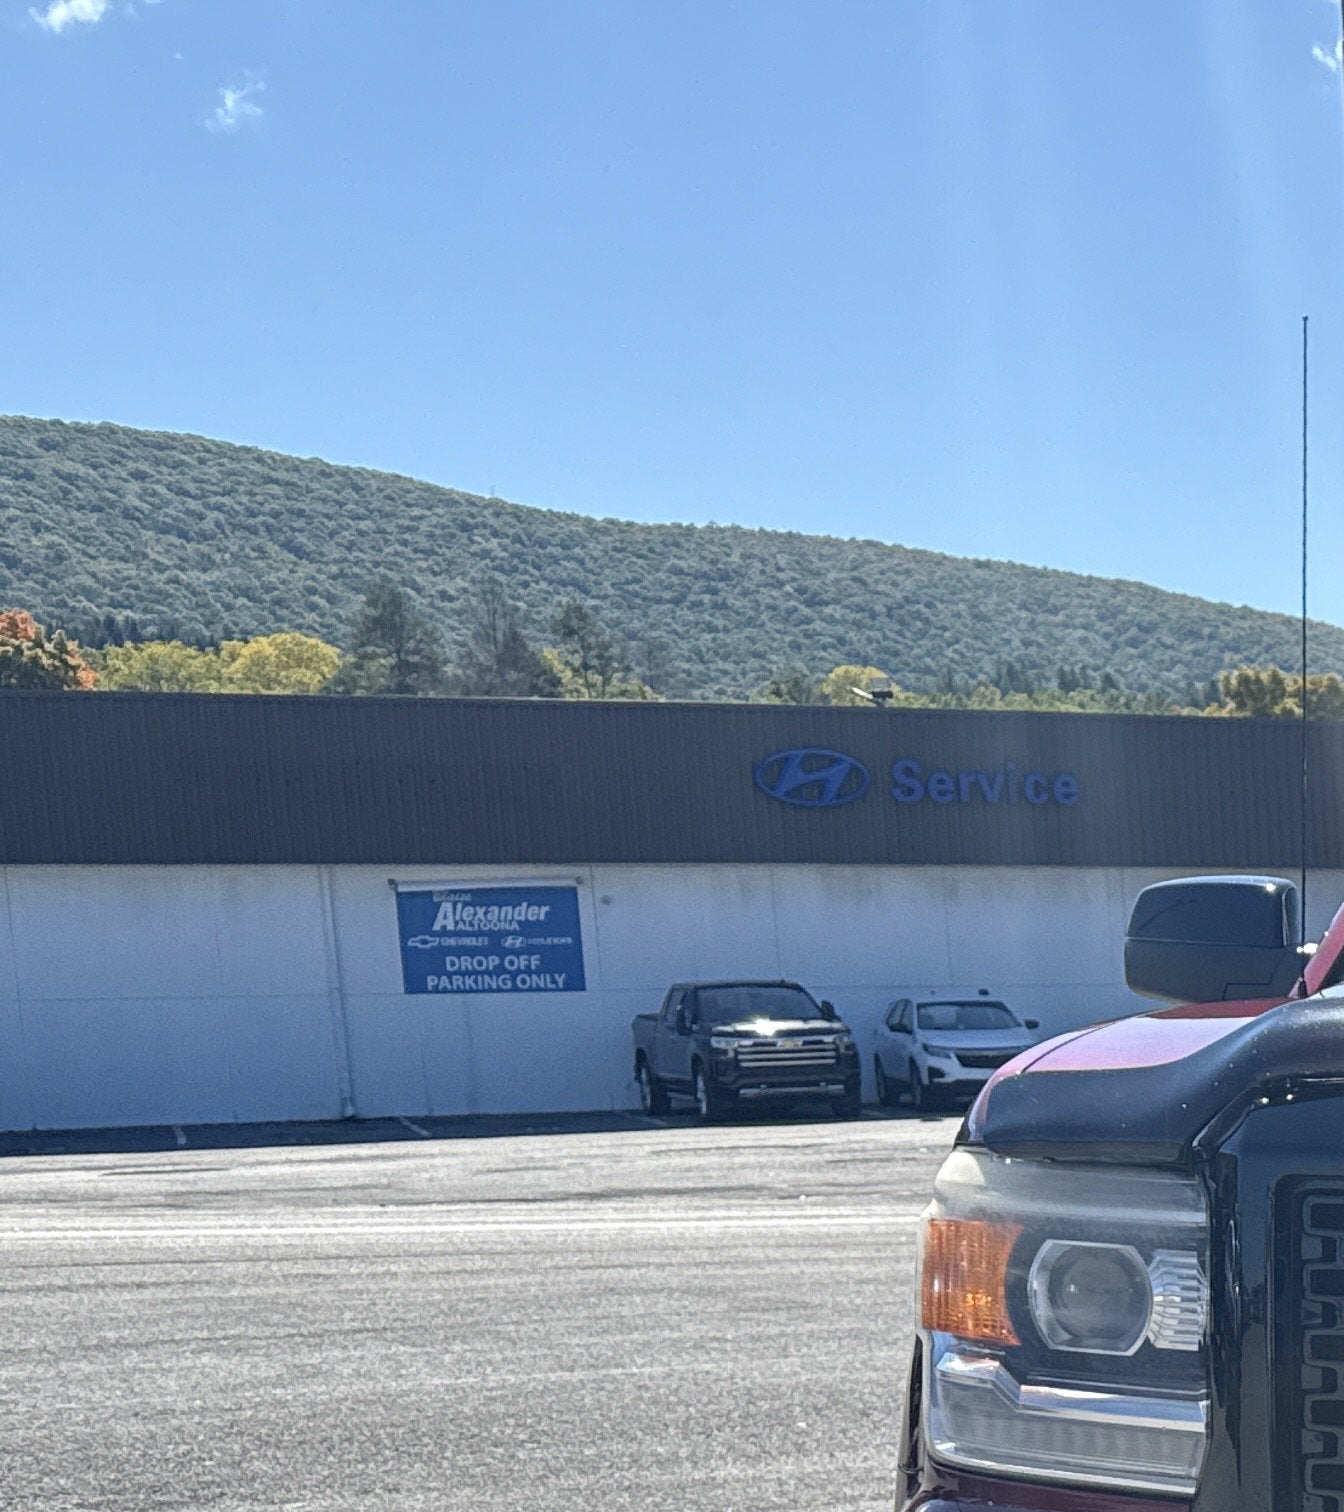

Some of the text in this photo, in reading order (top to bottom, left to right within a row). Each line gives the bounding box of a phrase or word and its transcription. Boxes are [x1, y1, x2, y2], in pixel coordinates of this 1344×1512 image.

[891, 758, 1079, 804] Service
[432, 902, 550, 931] Alexander
[455, 920, 520, 931] ALTOONA
[445, 955, 541, 971] DROP OFF
[426, 973, 566, 991] PARKING ONLY
